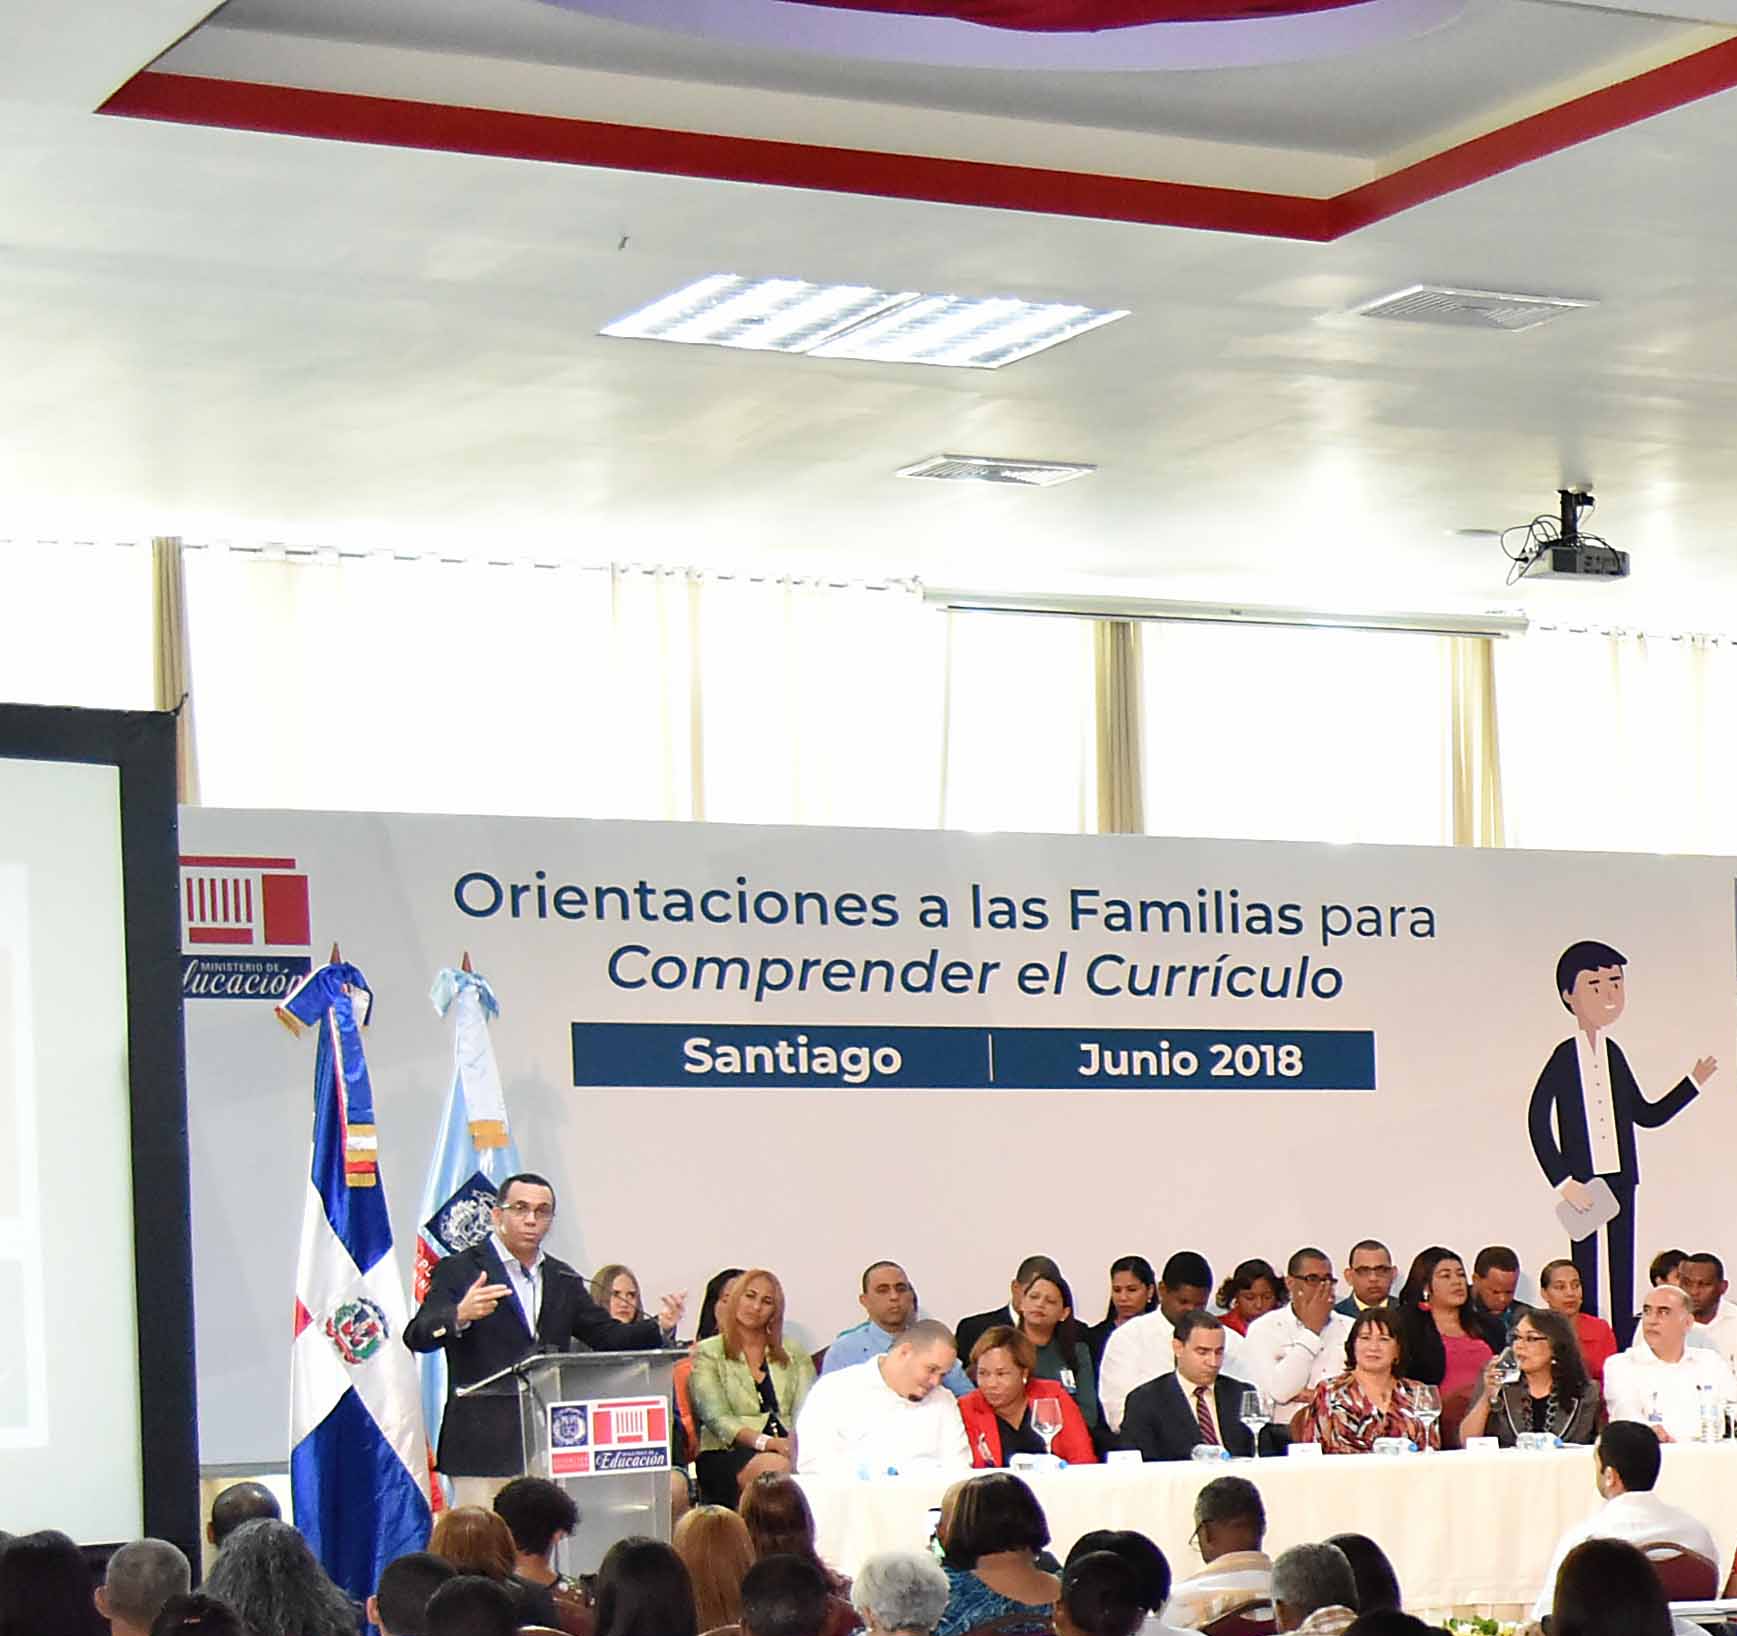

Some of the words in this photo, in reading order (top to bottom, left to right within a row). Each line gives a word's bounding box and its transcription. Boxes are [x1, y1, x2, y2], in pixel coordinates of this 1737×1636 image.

[454, 870, 900, 928] Orientaciones
[918, 893, 949, 928] a
[971, 884, 1050, 931] las
[1069, 888, 1304, 936] Familias
[1320, 902, 1437, 947] para
[201, 961, 264, 973] MINISTERIO
[266, 962, 279, 973] DE
[607, 944, 1001, 1002] Comprender
[1017, 951, 1068, 996] el
[1086, 953, 1344, 1000] Currículo
[682, 1035, 902, 1084] Santiago
[1077, 1040, 1200, 1078] Junio
[1208, 1043, 1304, 1078] 2018
